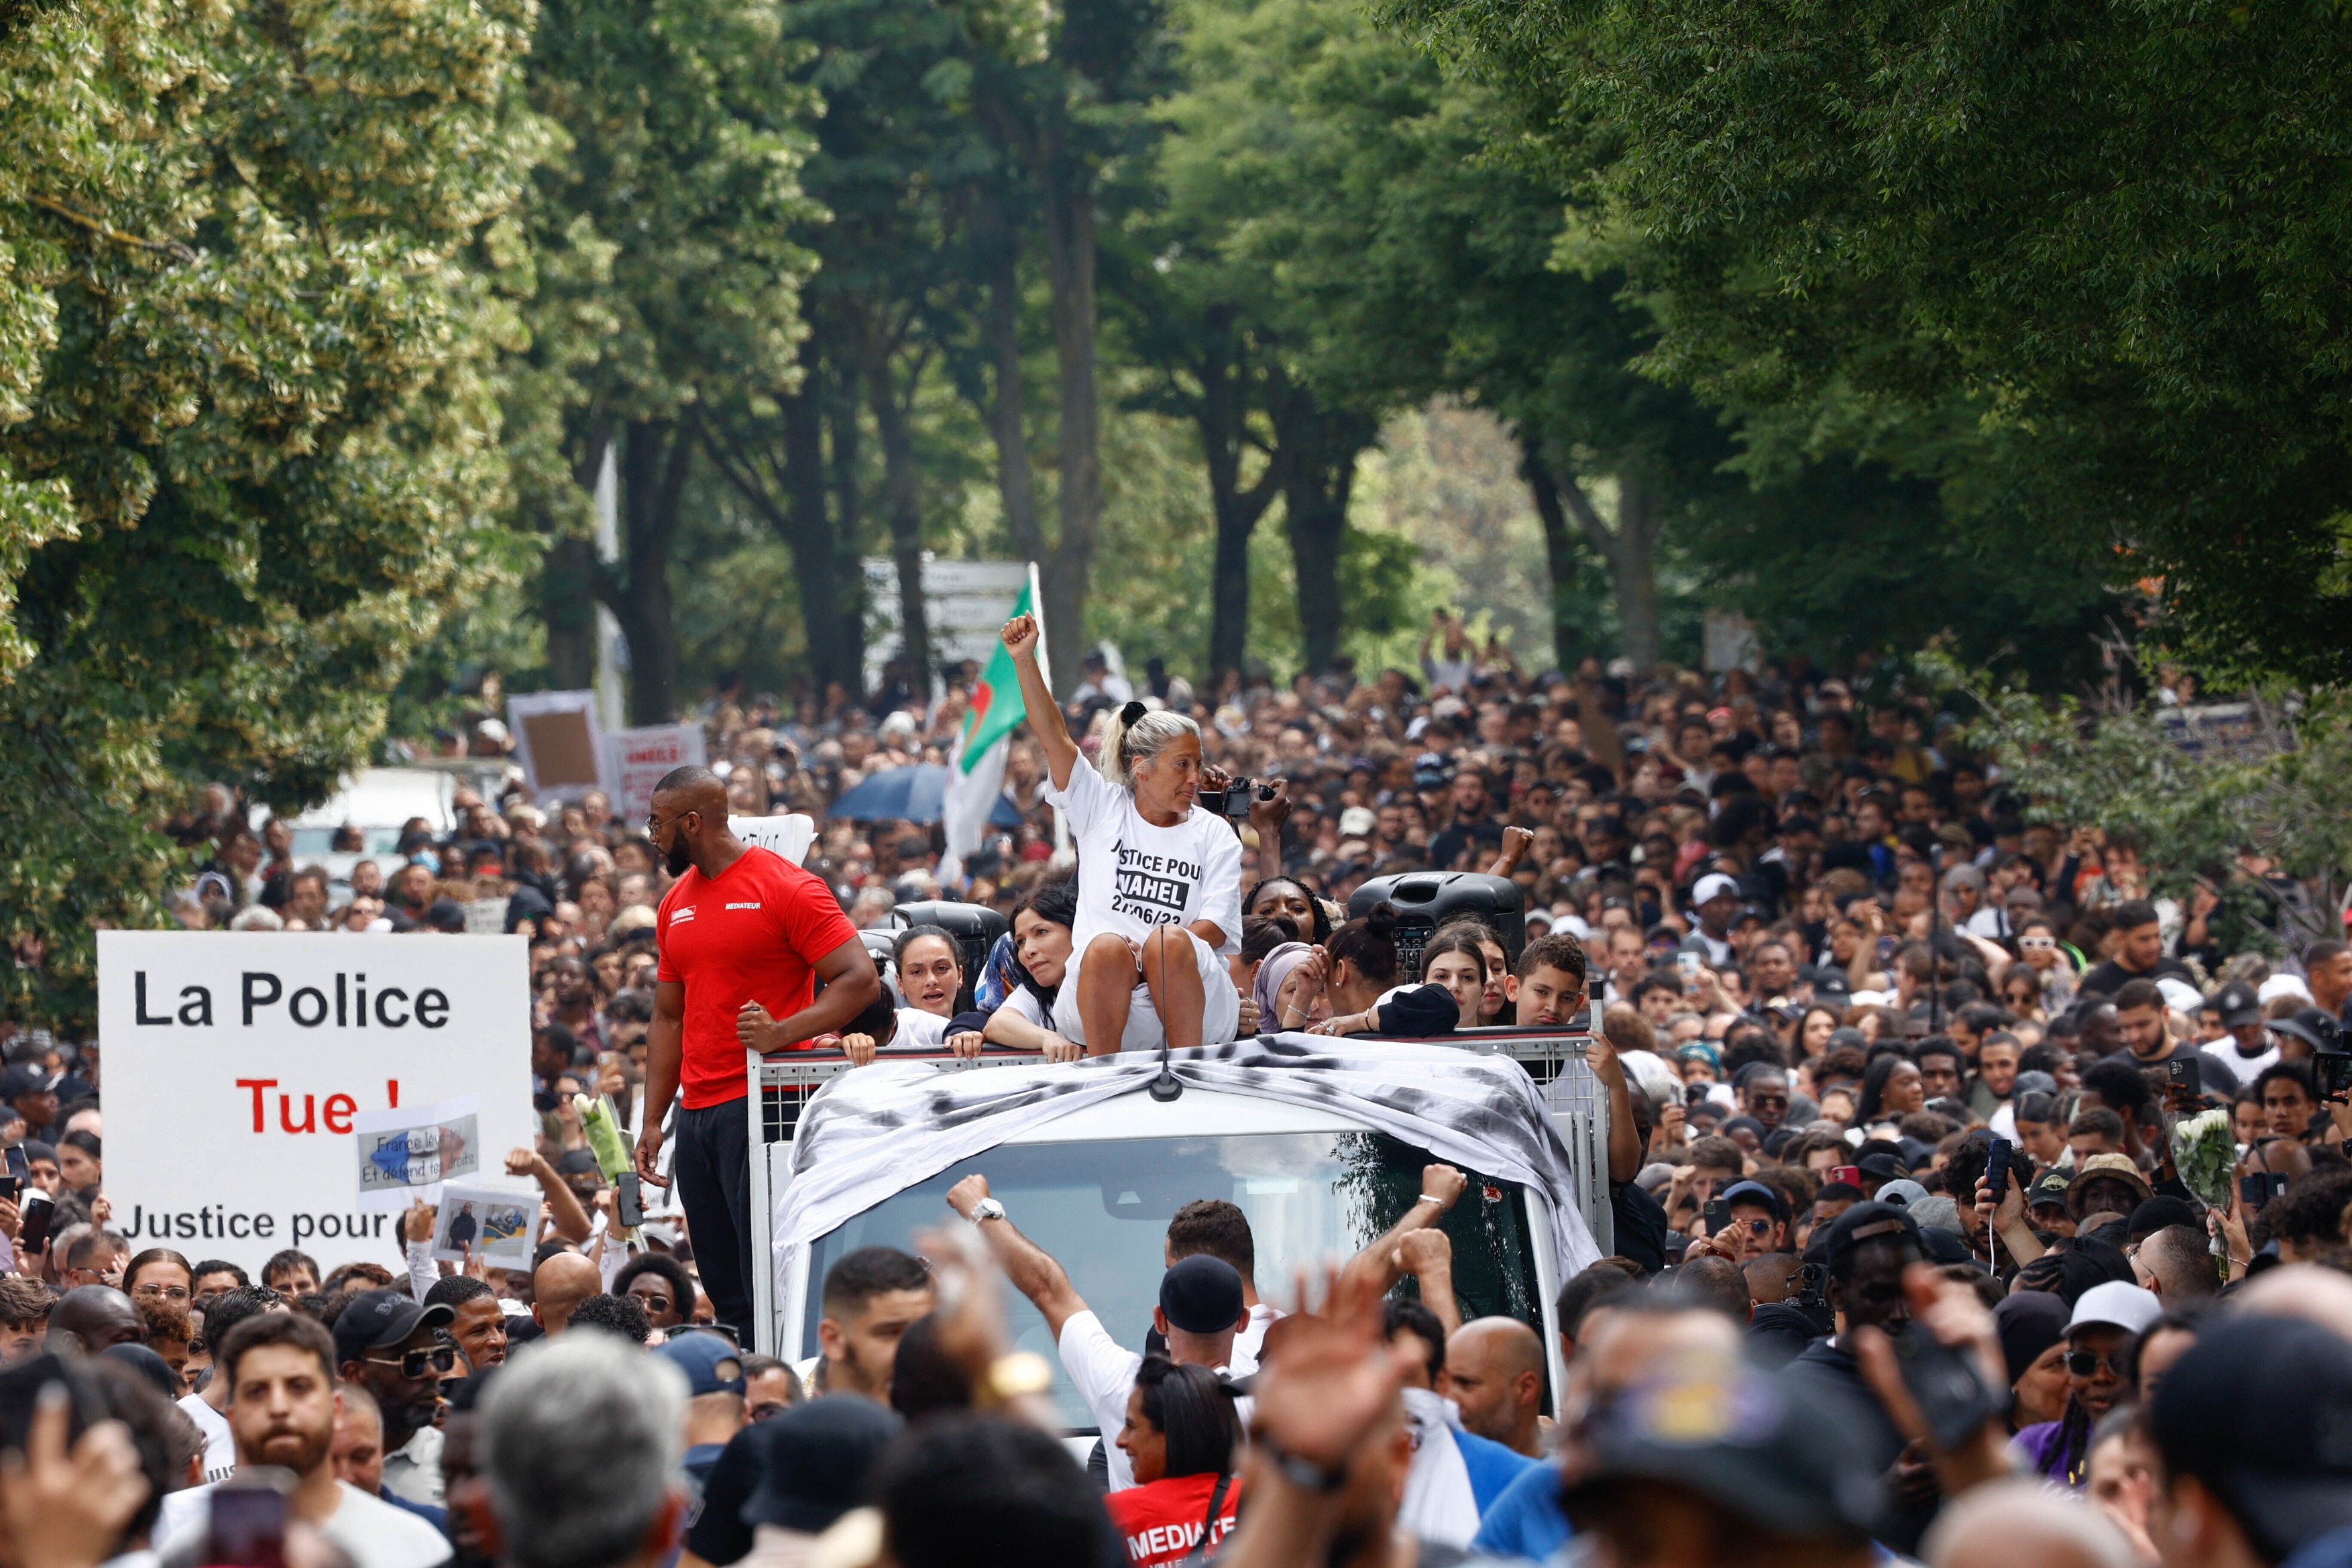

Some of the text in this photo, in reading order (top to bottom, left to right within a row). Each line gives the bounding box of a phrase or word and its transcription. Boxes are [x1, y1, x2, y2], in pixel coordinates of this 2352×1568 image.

[1111, 838, 1201, 883] JSTICE POU
[725, 902, 761, 910] MEDIATEUR
[1118, 873, 1181, 906] NAHEL
[135, 971, 449, 1029] La Police
[236, 1079, 357, 1134] Tue
[377, 1136, 422, 1153] France
[363, 1165, 377, 1182] Et
[383, 1160, 425, 1180] défend
[121, 1205, 388, 1246] Justice pour
